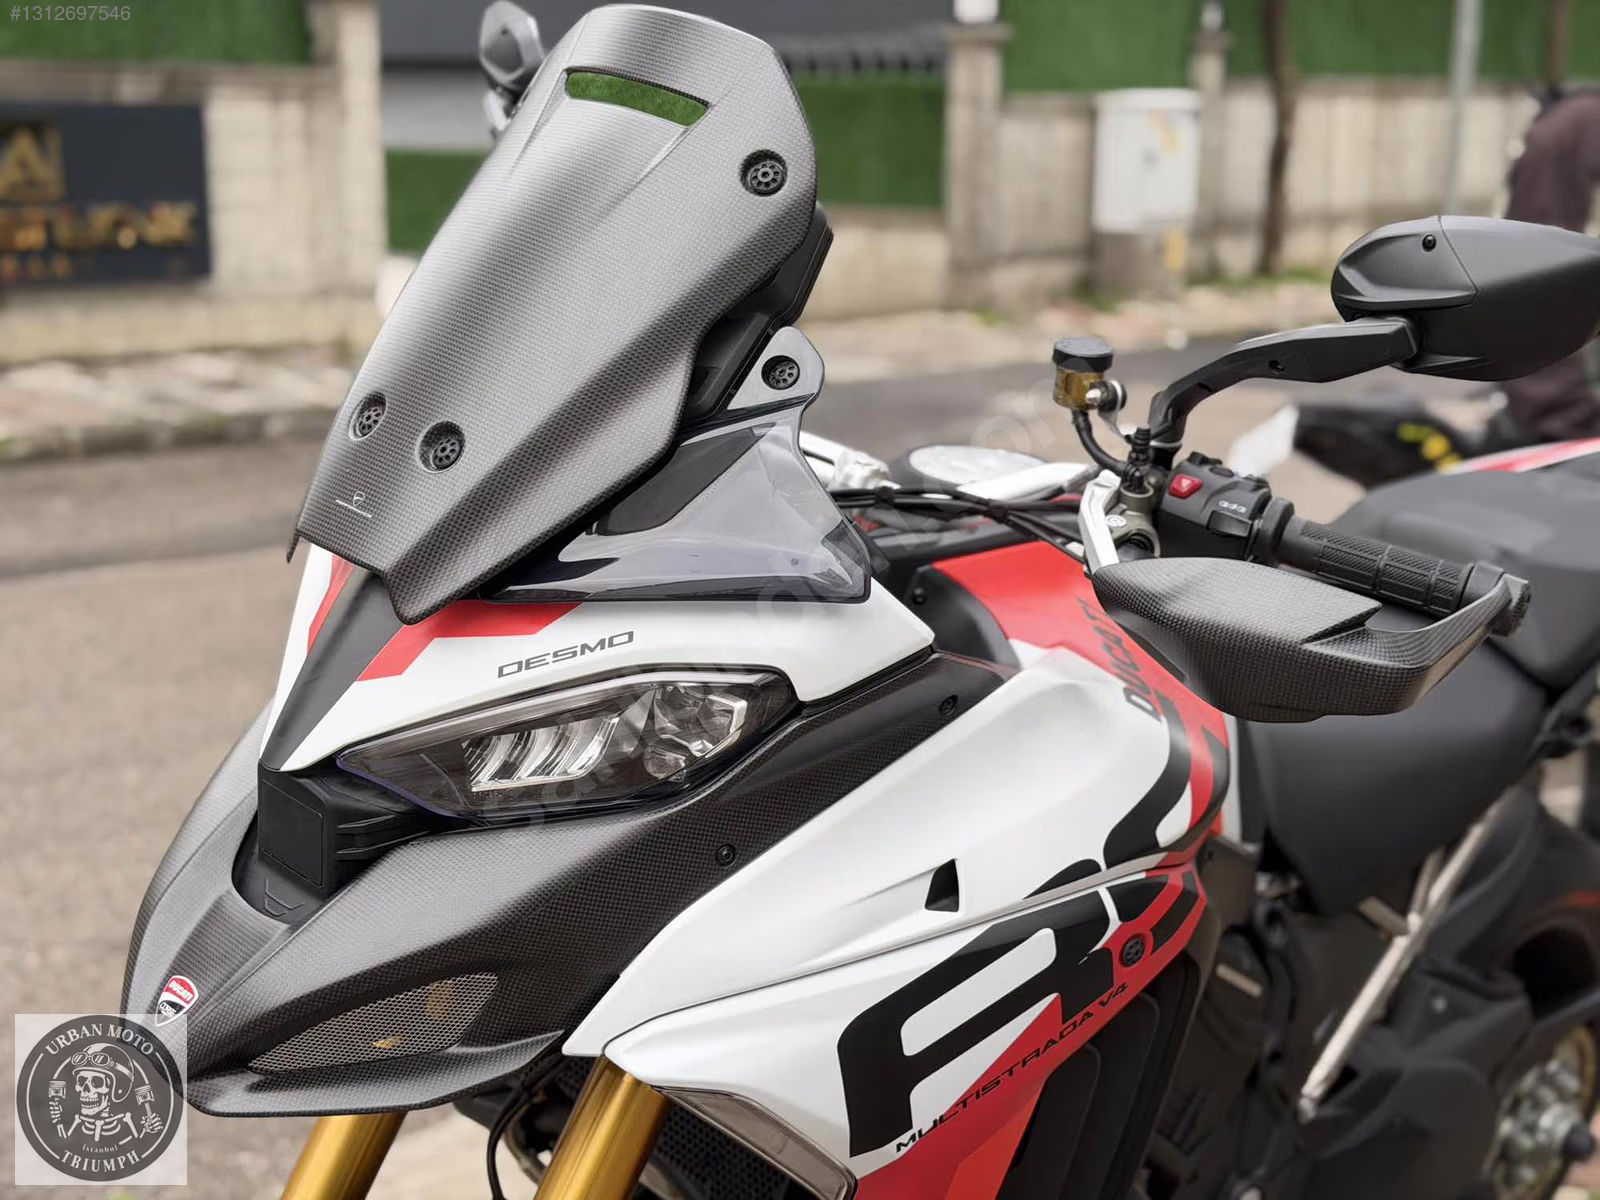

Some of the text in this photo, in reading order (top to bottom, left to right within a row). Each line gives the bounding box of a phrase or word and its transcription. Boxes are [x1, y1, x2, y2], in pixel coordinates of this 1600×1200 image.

[497, 630, 635, 679] DESMO
[895, 981, 1128, 1153] MULTISTRADA V4
